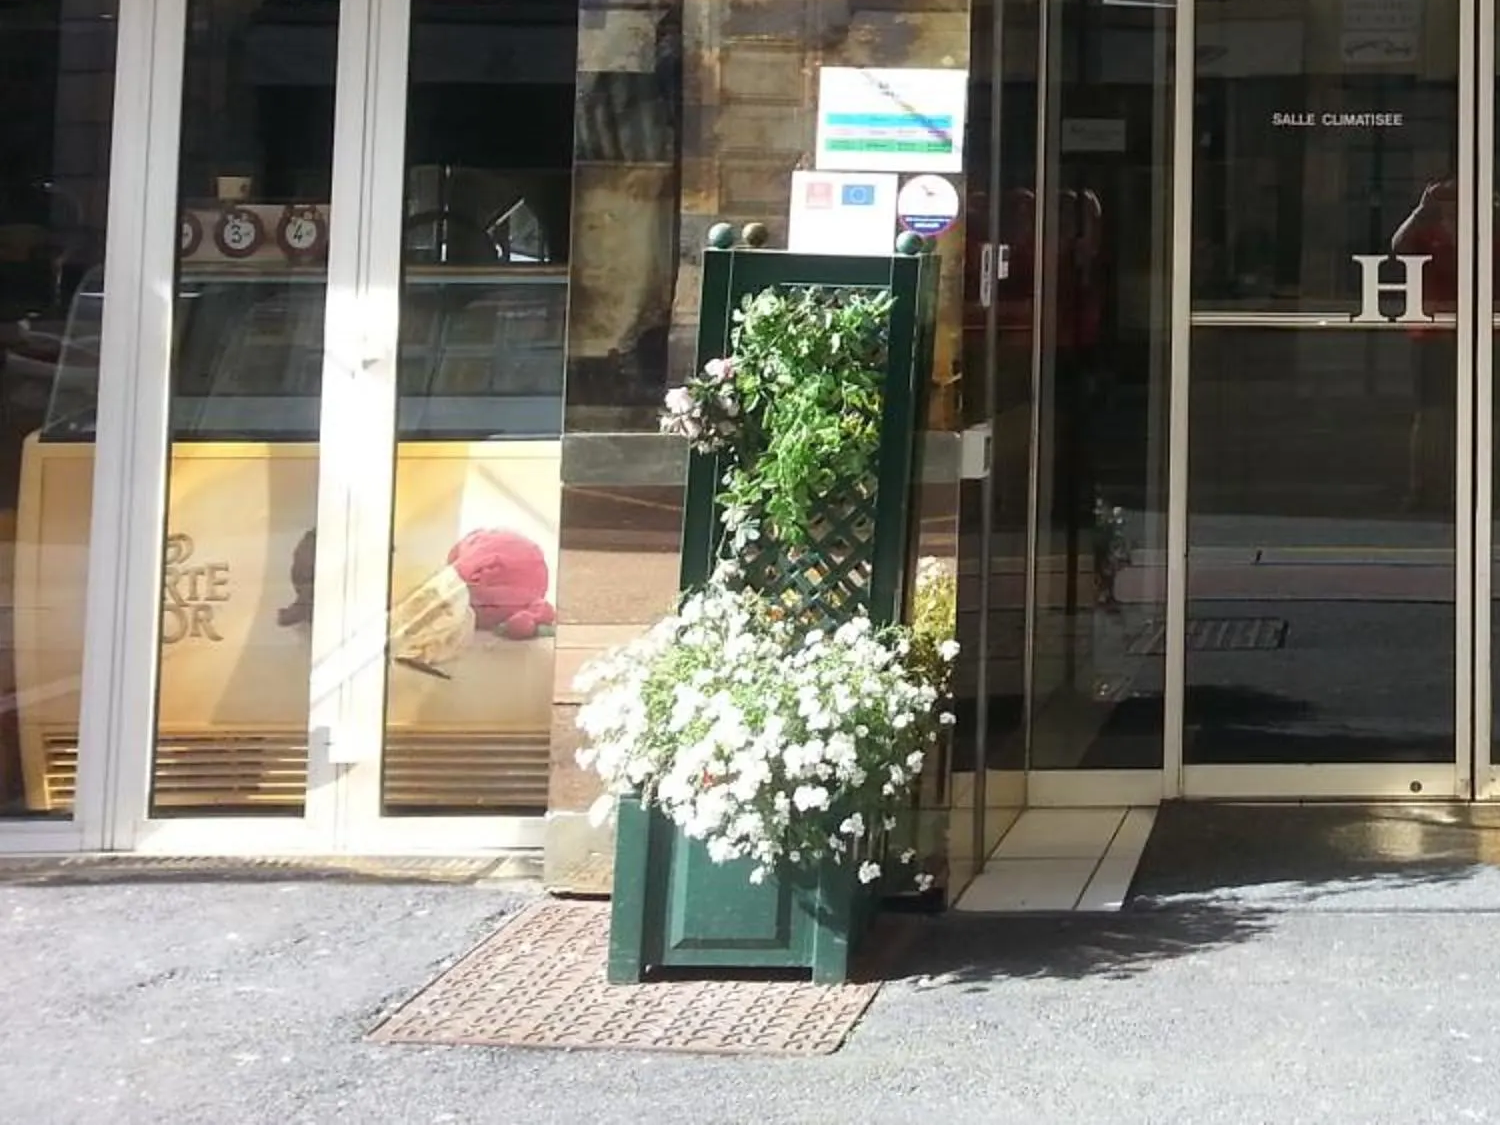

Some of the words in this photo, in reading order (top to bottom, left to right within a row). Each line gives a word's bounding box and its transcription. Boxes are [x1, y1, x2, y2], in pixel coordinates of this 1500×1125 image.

[1272, 112, 1316, 126] SALLE
[1321, 112, 1404, 126] CLIMATISEE
[1352, 254, 1433, 322] H
[165, 562, 231, 608] RTE
